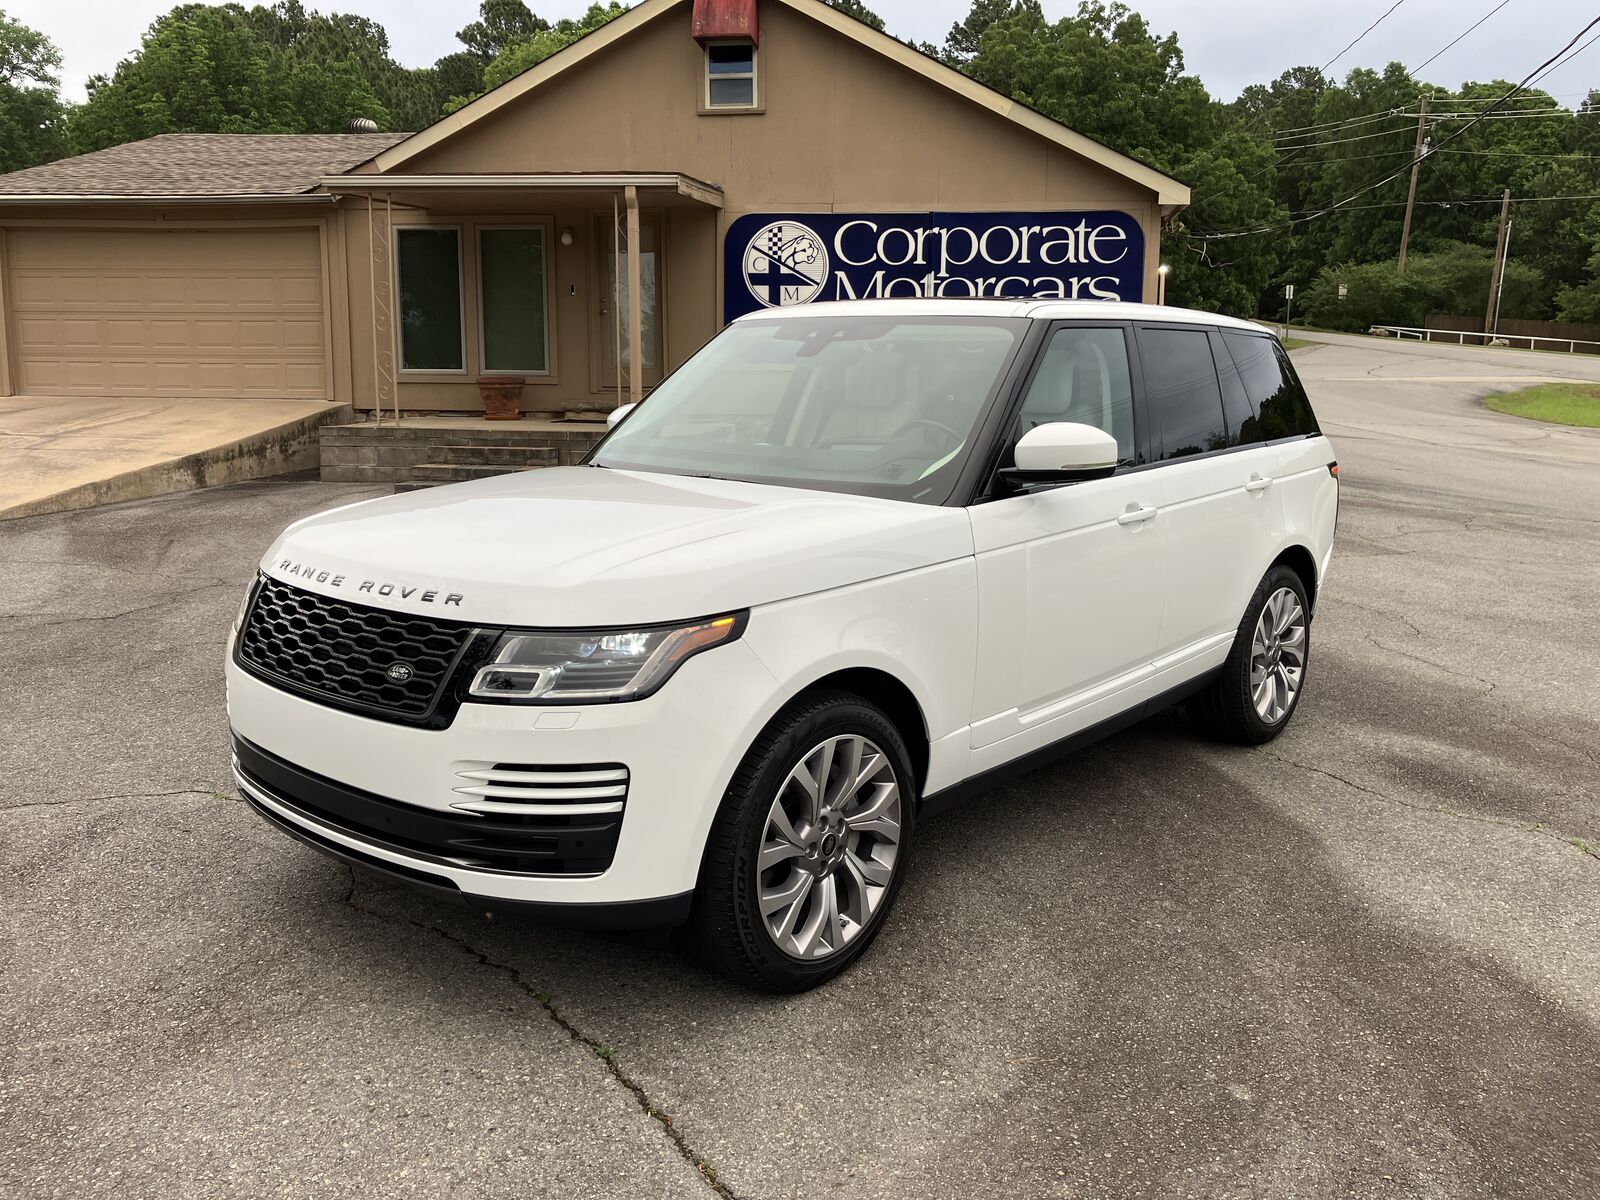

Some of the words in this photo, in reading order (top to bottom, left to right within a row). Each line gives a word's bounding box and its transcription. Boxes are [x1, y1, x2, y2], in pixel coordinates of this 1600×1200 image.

[752, 256, 766, 272] C
[834, 218, 1128, 277] Corporate
[783, 286, 799, 301] M
[280, 560, 345, 587] RANGE
[359, 580, 464, 607] ROVER
[737, 856, 768, 966] SCORPION
